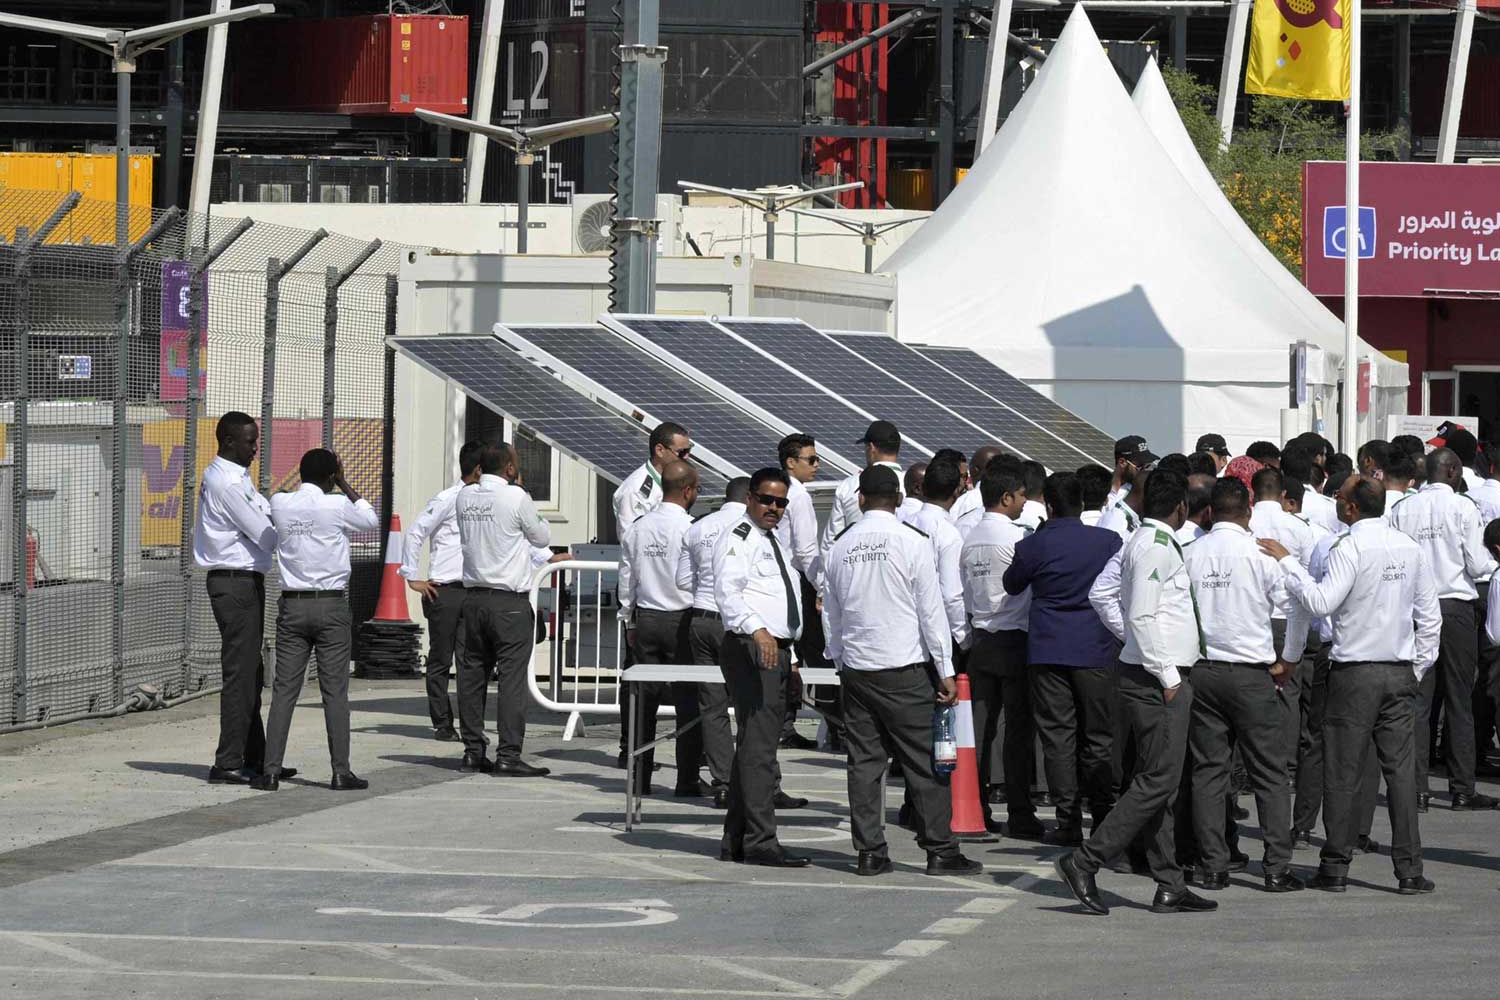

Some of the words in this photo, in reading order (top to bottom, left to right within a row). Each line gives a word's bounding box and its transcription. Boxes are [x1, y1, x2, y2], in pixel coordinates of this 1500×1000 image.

[506, 40, 549, 111] L2
[1398, 211, 1457, 235] المرور
[1388, 241, 1472, 265] Priority
[842, 552, 889, 565] SECURITY
